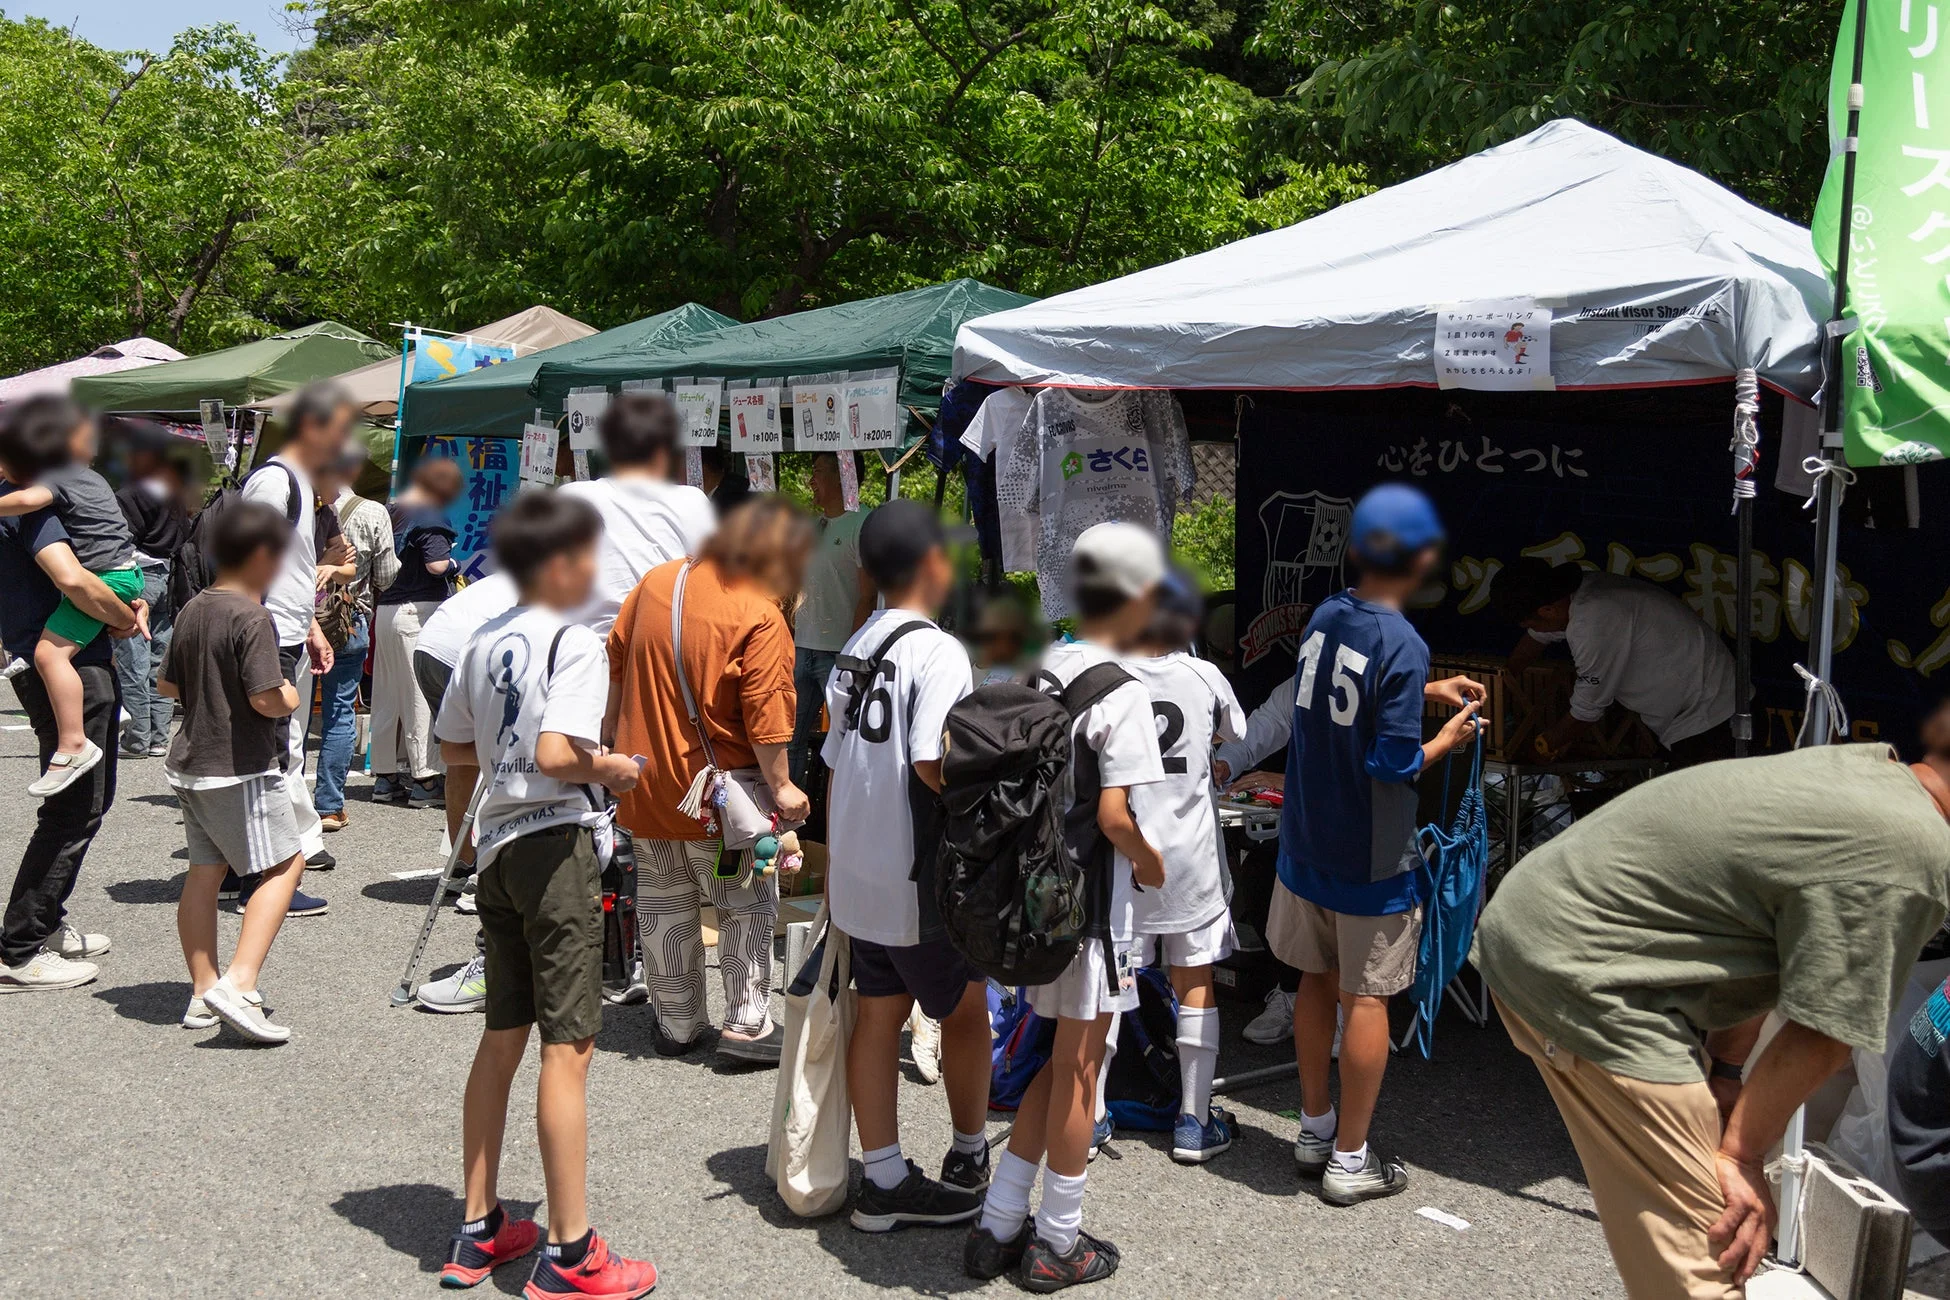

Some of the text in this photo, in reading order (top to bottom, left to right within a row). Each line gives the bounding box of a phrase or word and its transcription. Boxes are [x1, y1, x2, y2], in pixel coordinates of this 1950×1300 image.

[1448, 312, 1534, 321] サッカーボーリング
[1579, 306, 1620, 318] Instant
[1621, 306, 1654, 318] Visor
[1447, 331, 1496, 339] 1回100円
[733, 395, 764, 406] ジュース各種
[691, 428, 716, 438] 1本200円
[752, 432, 779, 442] 1本100円
[863, 430, 892, 442] 1本200円
[1087, 446, 1149, 473] さくら
[1377, 436, 1589, 478] 心をひとつに
[1252, 607, 1287, 650] CANVAS
[1294, 630, 1370, 727] 15
[1151, 700, 1188, 774] 2
[508, 806, 556, 830] CANVAS
